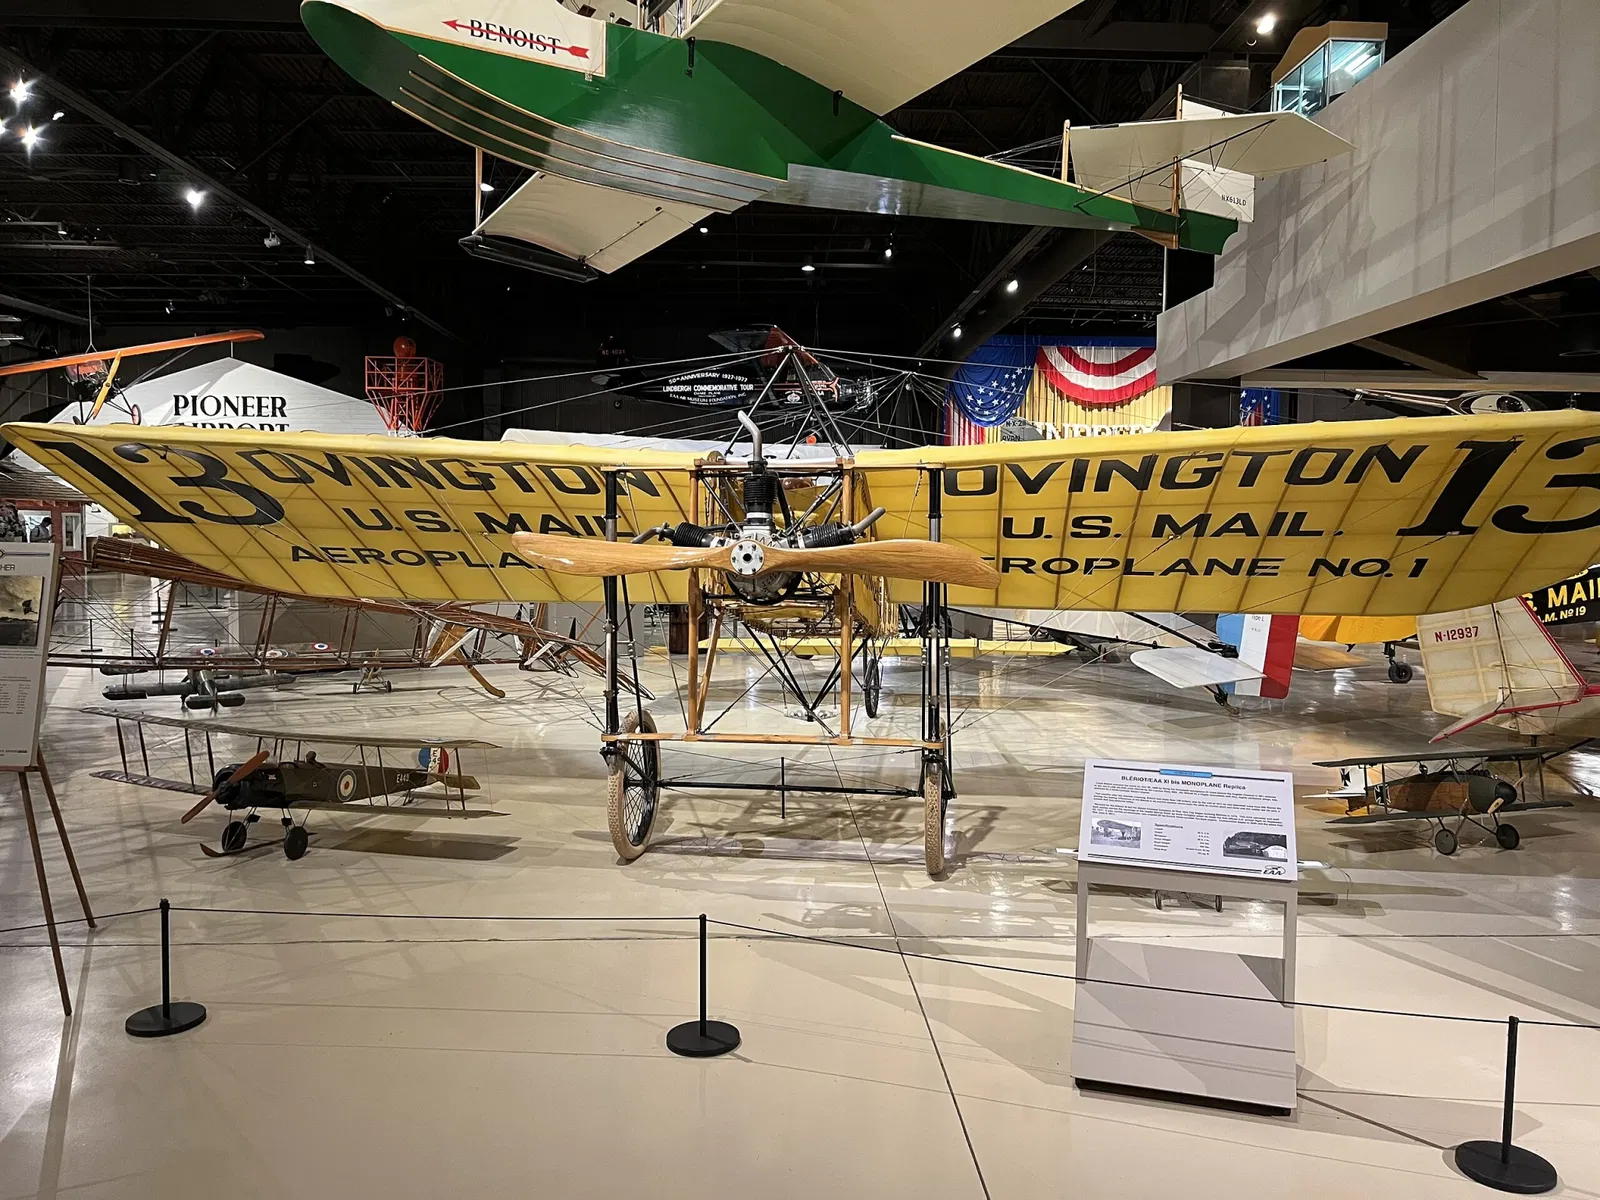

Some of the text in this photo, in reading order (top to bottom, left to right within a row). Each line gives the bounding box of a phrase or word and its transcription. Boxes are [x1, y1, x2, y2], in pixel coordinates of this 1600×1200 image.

[470, 19, 561, 54] BENOIST
[662, 383, 754, 393] LINDBERGH COMMEMORATIVE TOUR
[680, 372, 720, 382] ANNIVERSARY
[173, 394, 288, 418] PIONEER
[943, 443, 1430, 497] OVINGTON
[31, 440, 662, 526] 13 OVINGTON
[291, 545, 547, 570] AEROPLA
[980, 557, 1285, 578] ROPLANE
[1547, 578, 1600, 608] MAI
[1575, 606, 1587, 617] 19
[1434, 626, 1479, 643] N-12937
[1181, 780, 1222, 789] MONOPLANE
[1223, 783, 1246, 791] Replica
